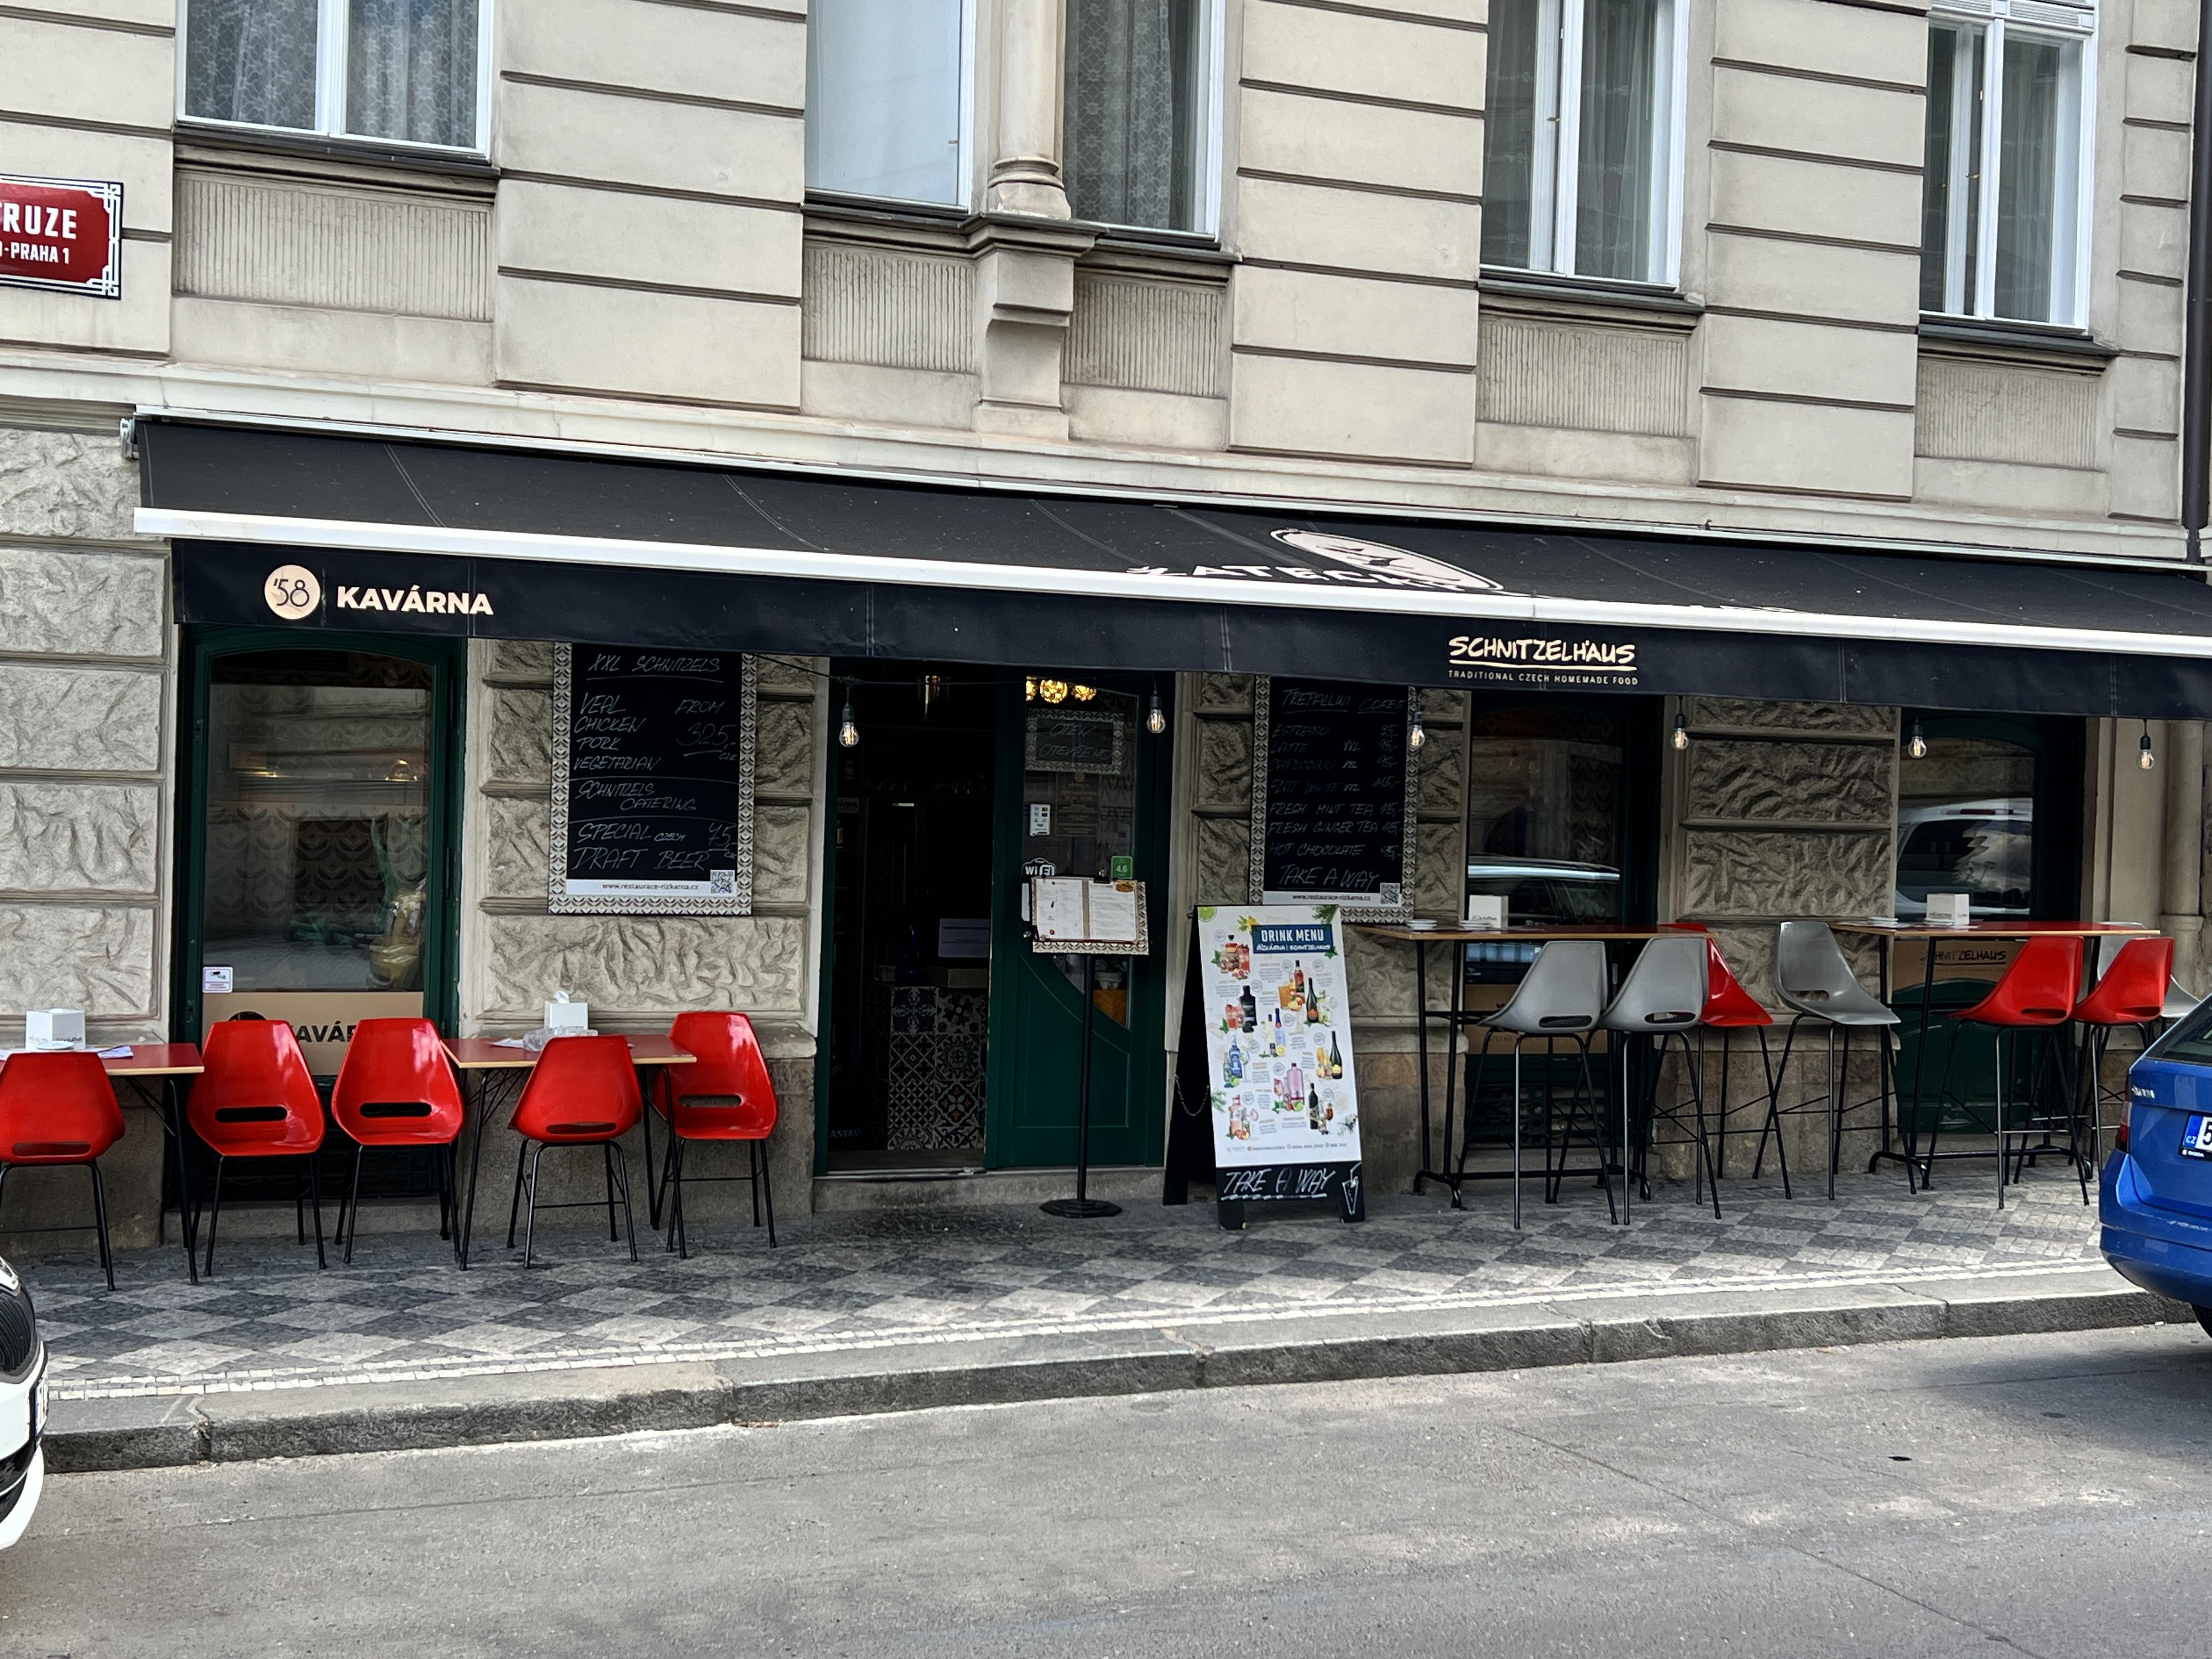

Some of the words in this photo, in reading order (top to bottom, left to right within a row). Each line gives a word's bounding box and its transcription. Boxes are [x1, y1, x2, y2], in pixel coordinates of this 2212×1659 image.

[0, 202, 77, 239] RUZE
[62, 247, 69, 264] 1
[337, 585, 494, 615] KAVÁRNA
[588, 654, 622, 672] XXL
[632, 655, 720, 672] SCHNITZELS
[1448, 670, 1514, 681] TRADITIONAL
[1519, 673, 1549, 682] CZECH
[1554, 675, 1608, 685] HOMEMADE
[1613, 676, 1638, 685] FOOD
[580, 692, 626, 714] VEAL
[675, 700, 725, 714] FROM
[574, 716, 646, 733] CHICKEN
[1050, 722, 1099, 738] OPEN
[577, 737, 621, 750] PORK
[1270, 742, 1309, 754] LATTE
[574, 756, 661, 770] VEGETARIAN
[575, 780, 655, 799] SCHNITZELS
[1267, 779, 1301, 795] FLAT
[619, 796, 697, 811] CATERING
[1349, 804, 1374, 817] TEA
[577, 823, 653, 843] SPECIAL
[1267, 821, 1308, 837] FRESH
[1356, 821, 1378, 833] TEA
[1267, 842, 1295, 856] HOT
[1297, 843, 1366, 856] CHOCOLATE
[571, 847, 649, 870] DRAFT
[653, 851, 710, 871] BEER
[1279, 864, 1323, 885] TAKE
[1261, 930, 1293, 942] DRINK
[1296, 928, 1324, 942] MENU
[2185, 1135, 2197, 1144] CZ
[1223, 1168, 1272, 1194] TAKE
